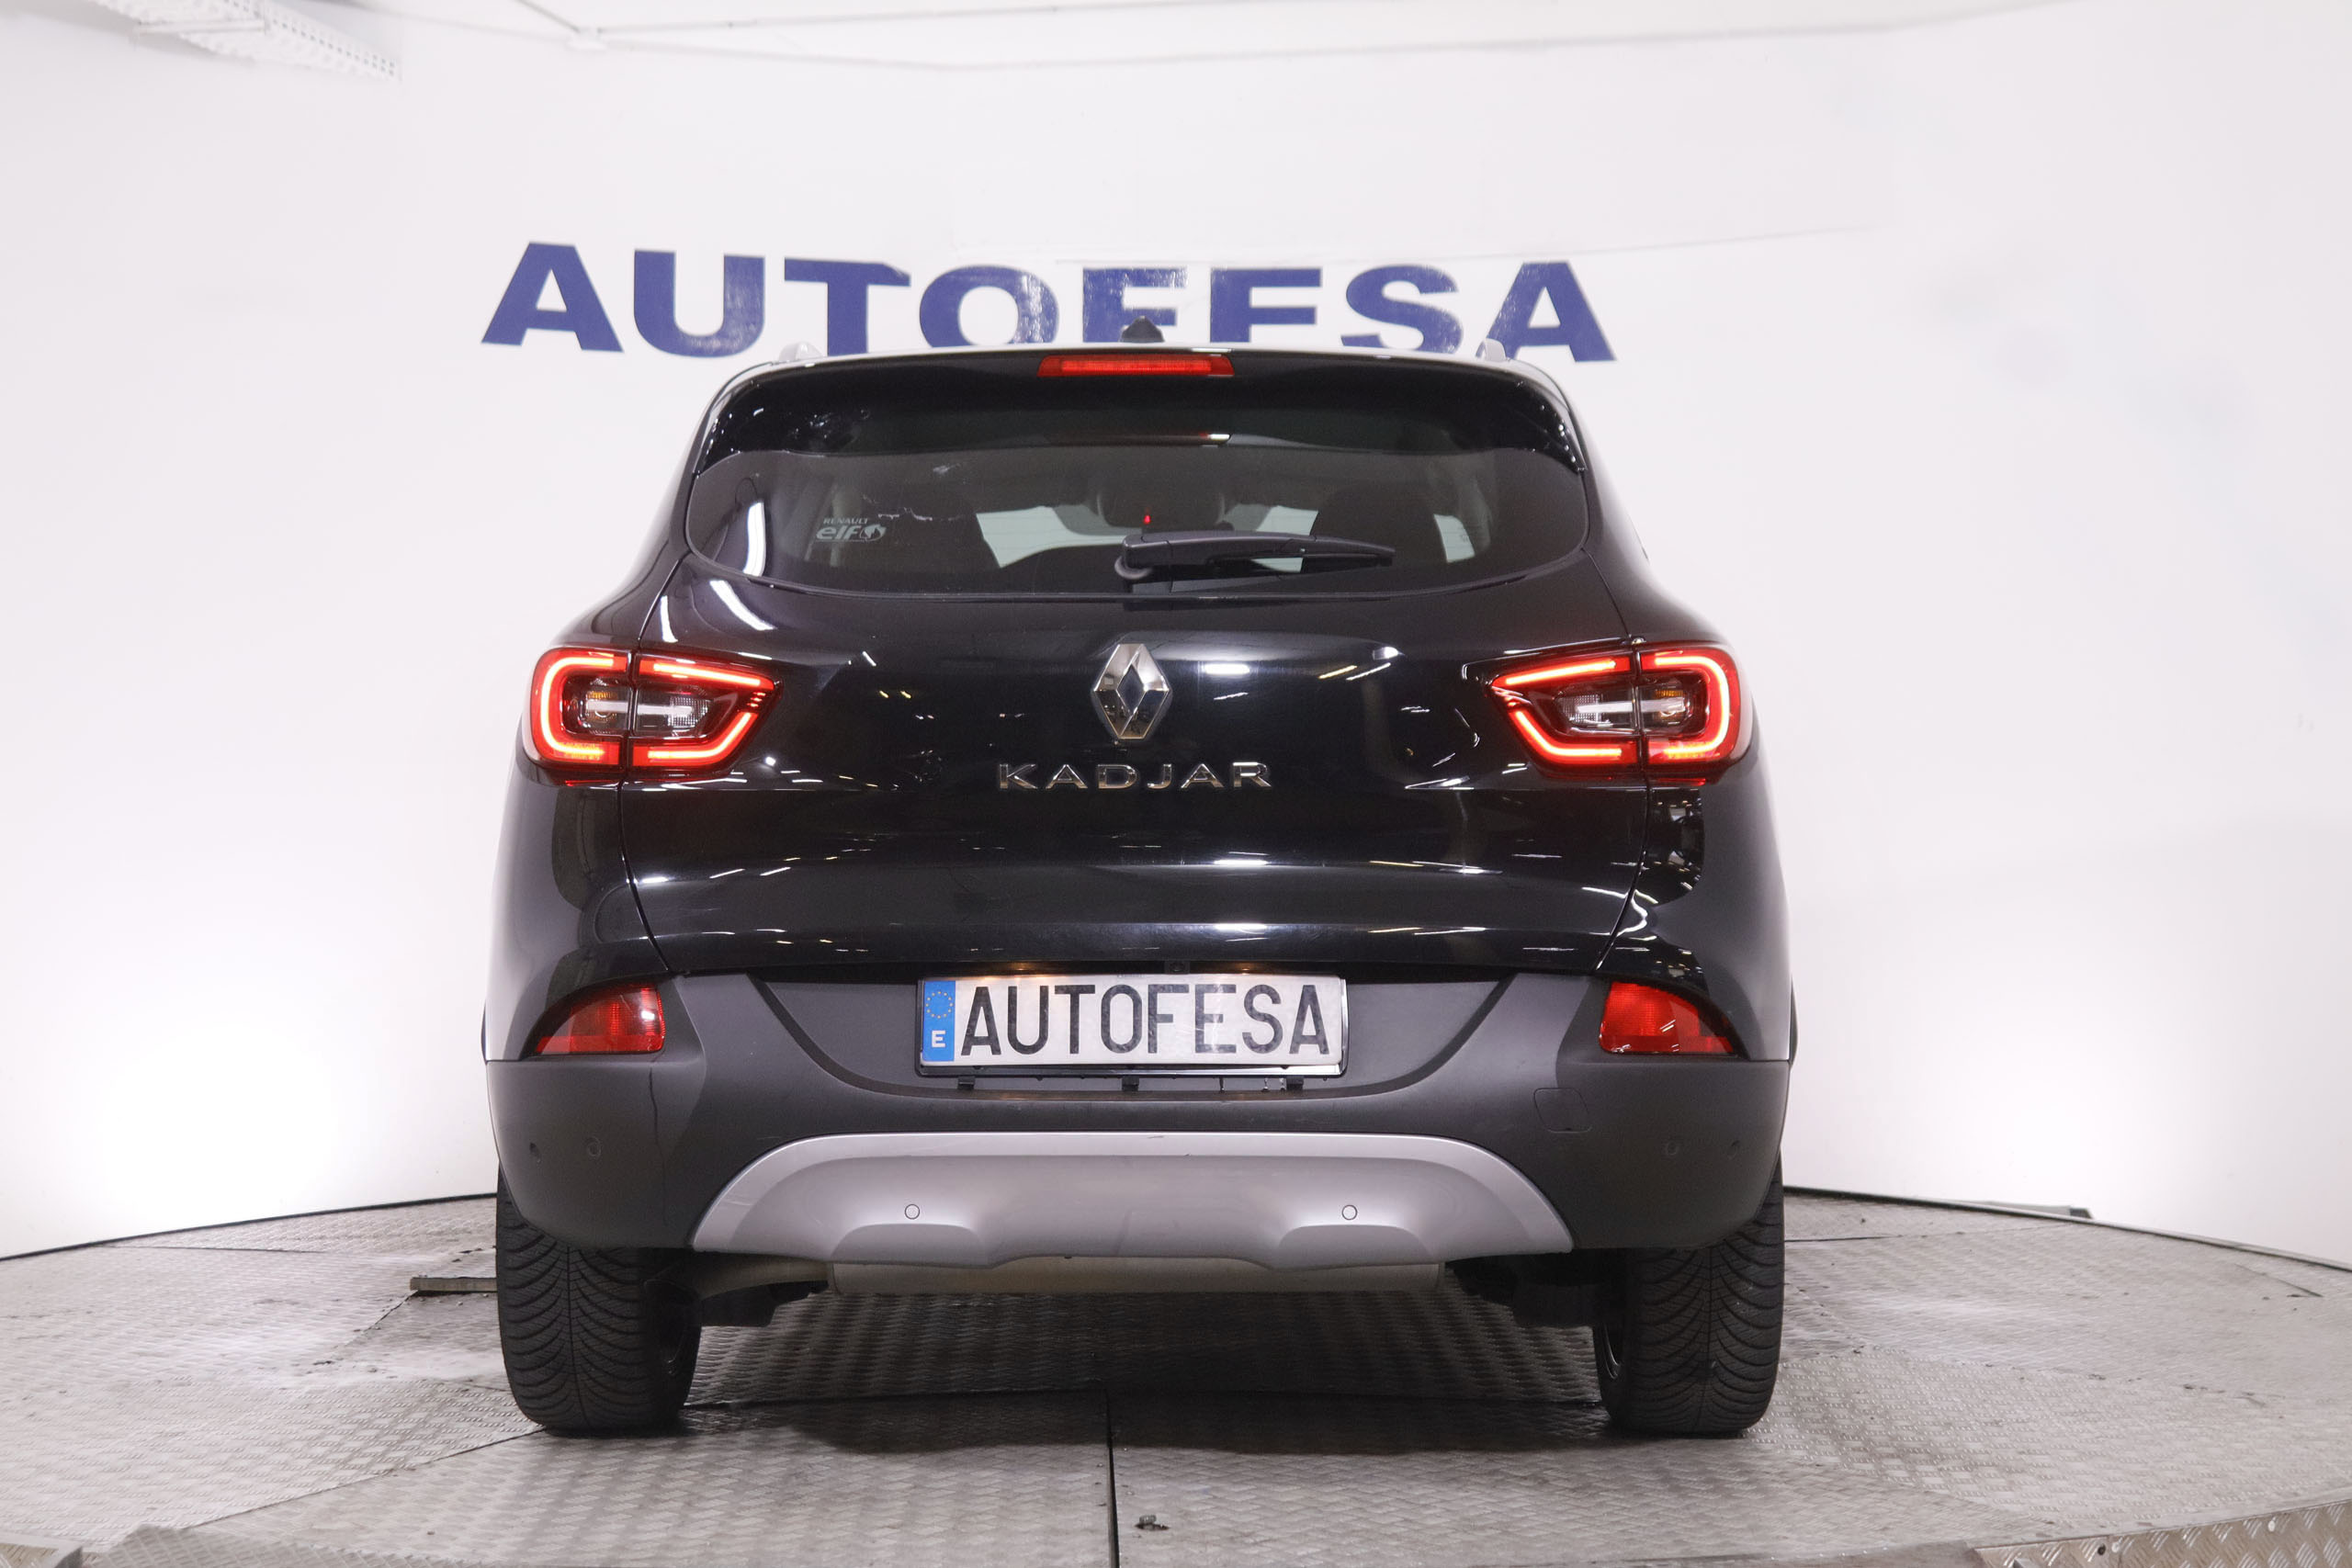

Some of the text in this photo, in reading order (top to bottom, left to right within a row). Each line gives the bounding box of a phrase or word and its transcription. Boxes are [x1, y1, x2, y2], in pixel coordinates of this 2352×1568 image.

[481, 241, 1618, 362] AUTOFESA
[816, 525, 862, 540] elf
[999, 761, 1272, 789] KADJAR
[931, 983, 1330, 1056] E AUTOFESA
